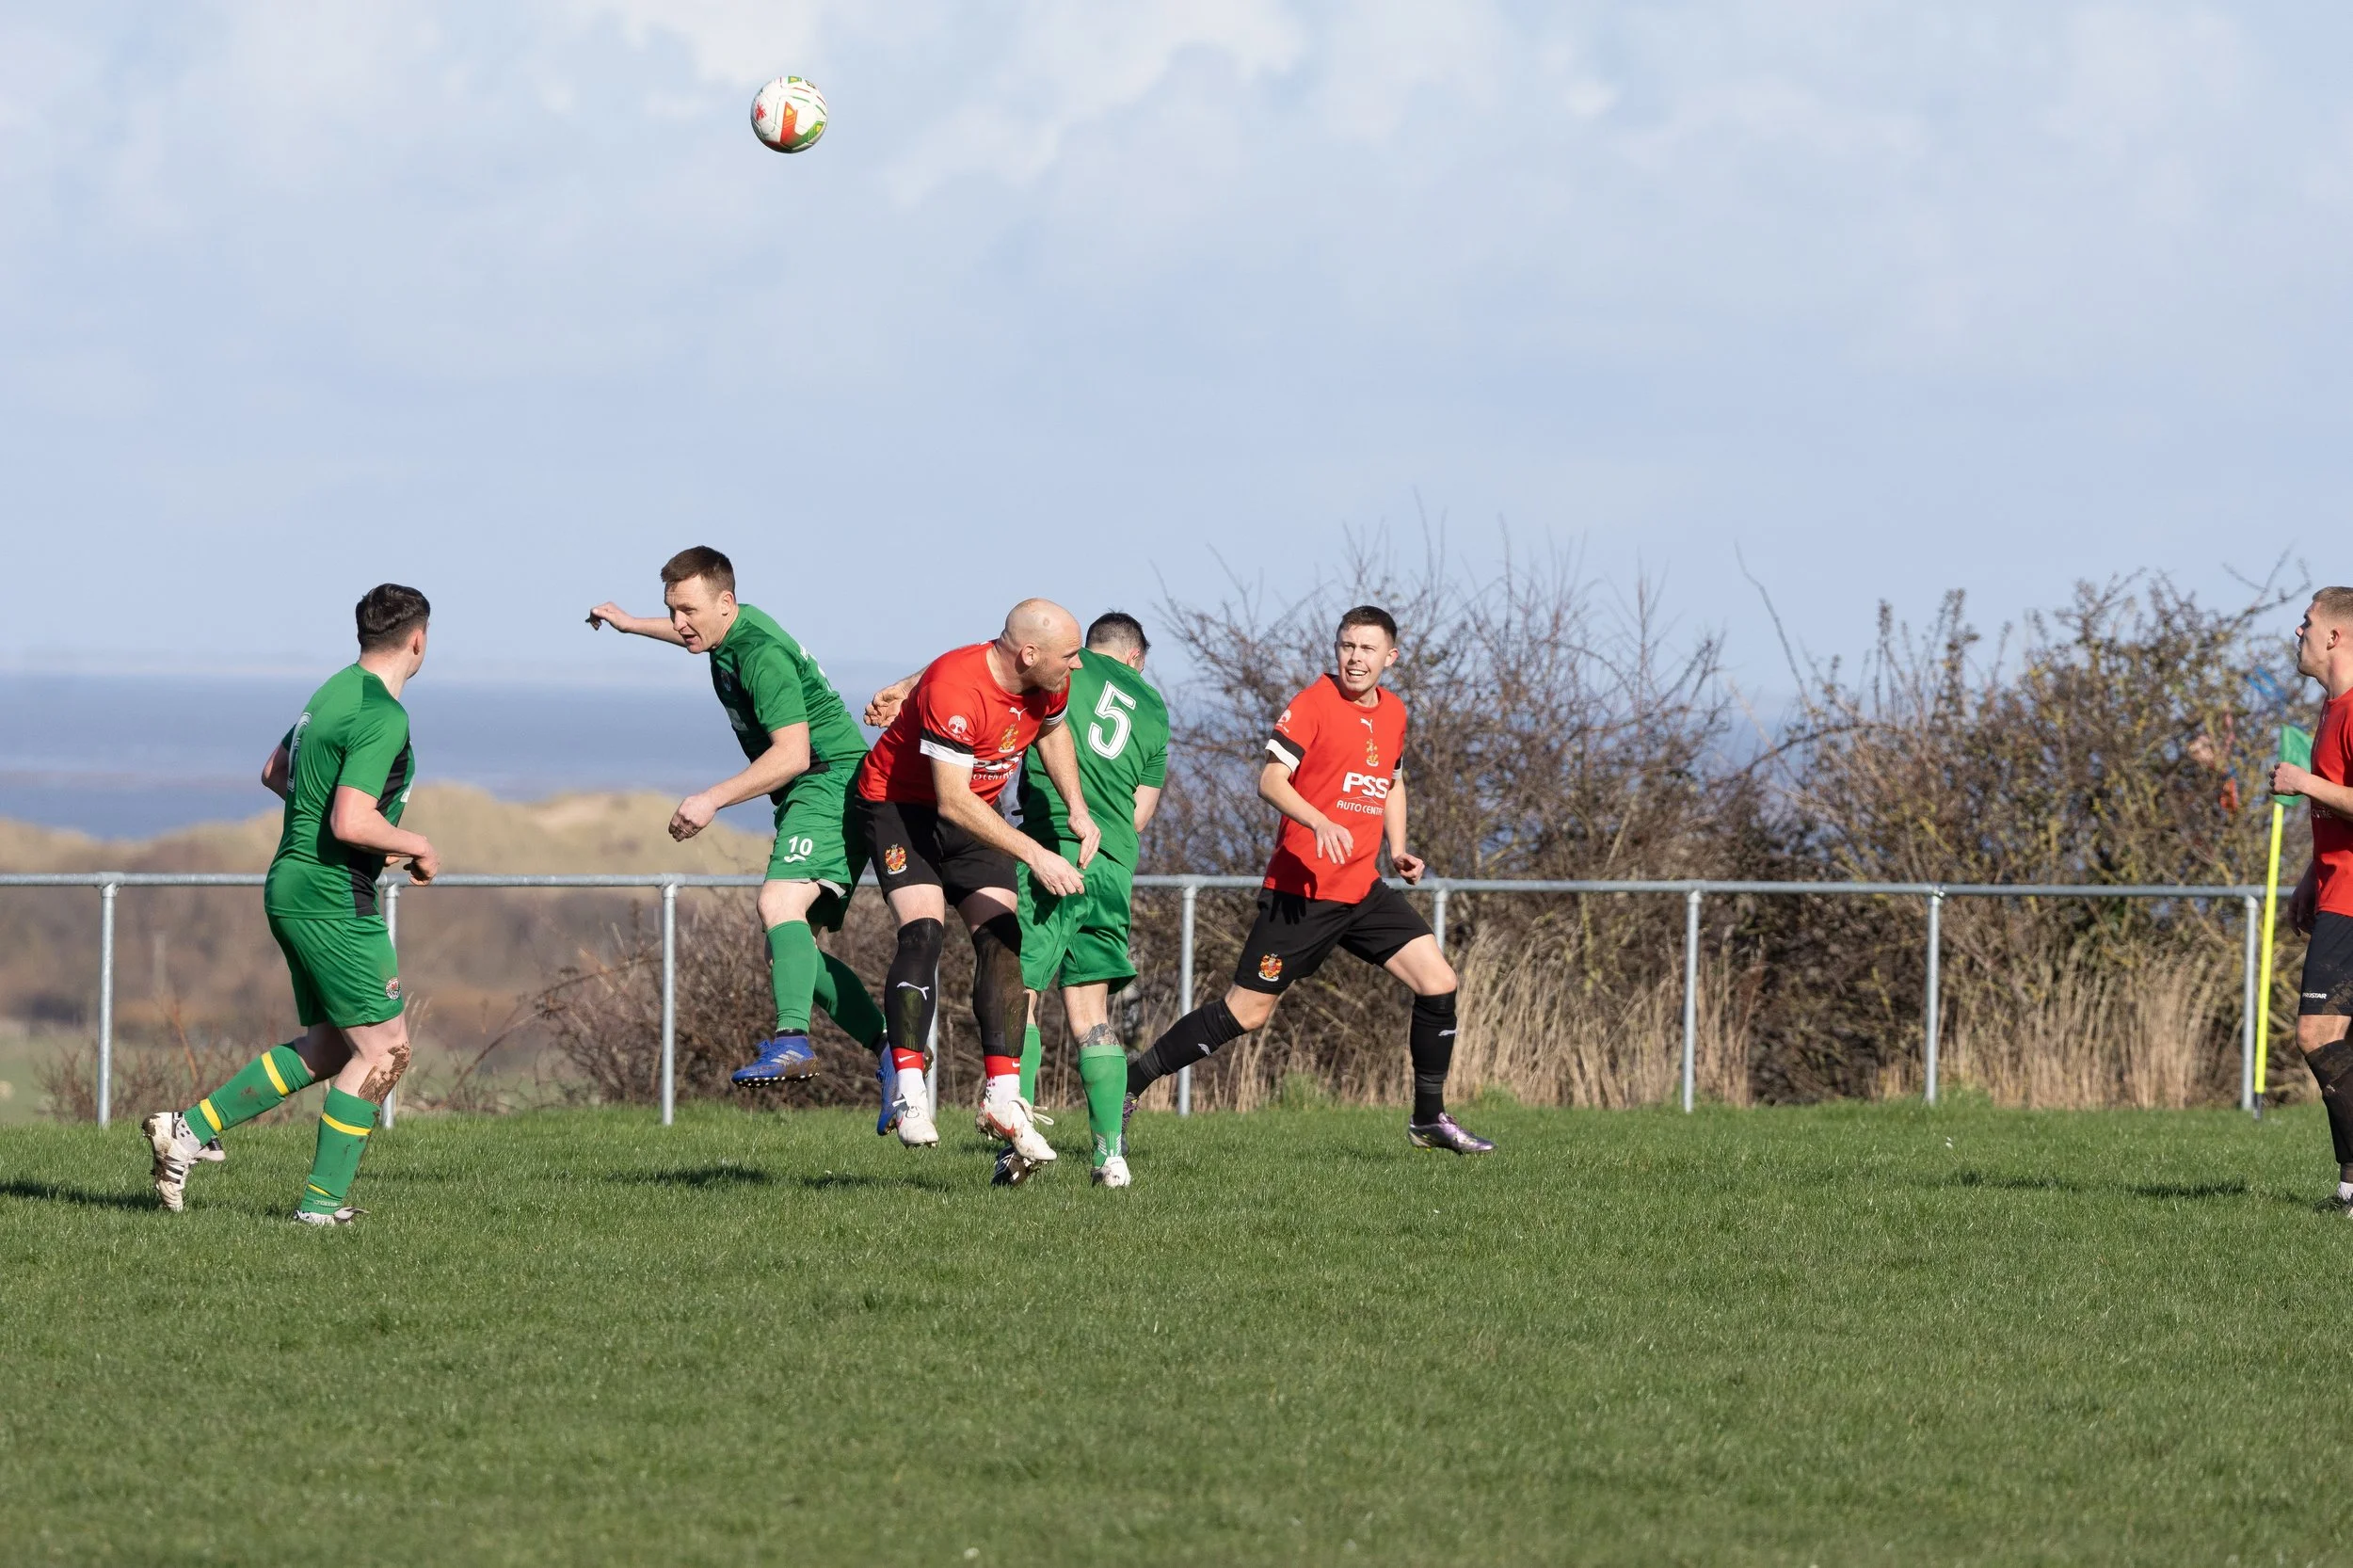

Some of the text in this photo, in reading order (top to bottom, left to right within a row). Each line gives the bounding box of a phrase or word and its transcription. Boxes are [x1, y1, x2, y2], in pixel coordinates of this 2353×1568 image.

[1088, 680, 1136, 760] 5
[1342, 772, 1390, 799] PSS
[1337, 800, 1362, 812] AUTO
[789, 836, 813, 856] 10
